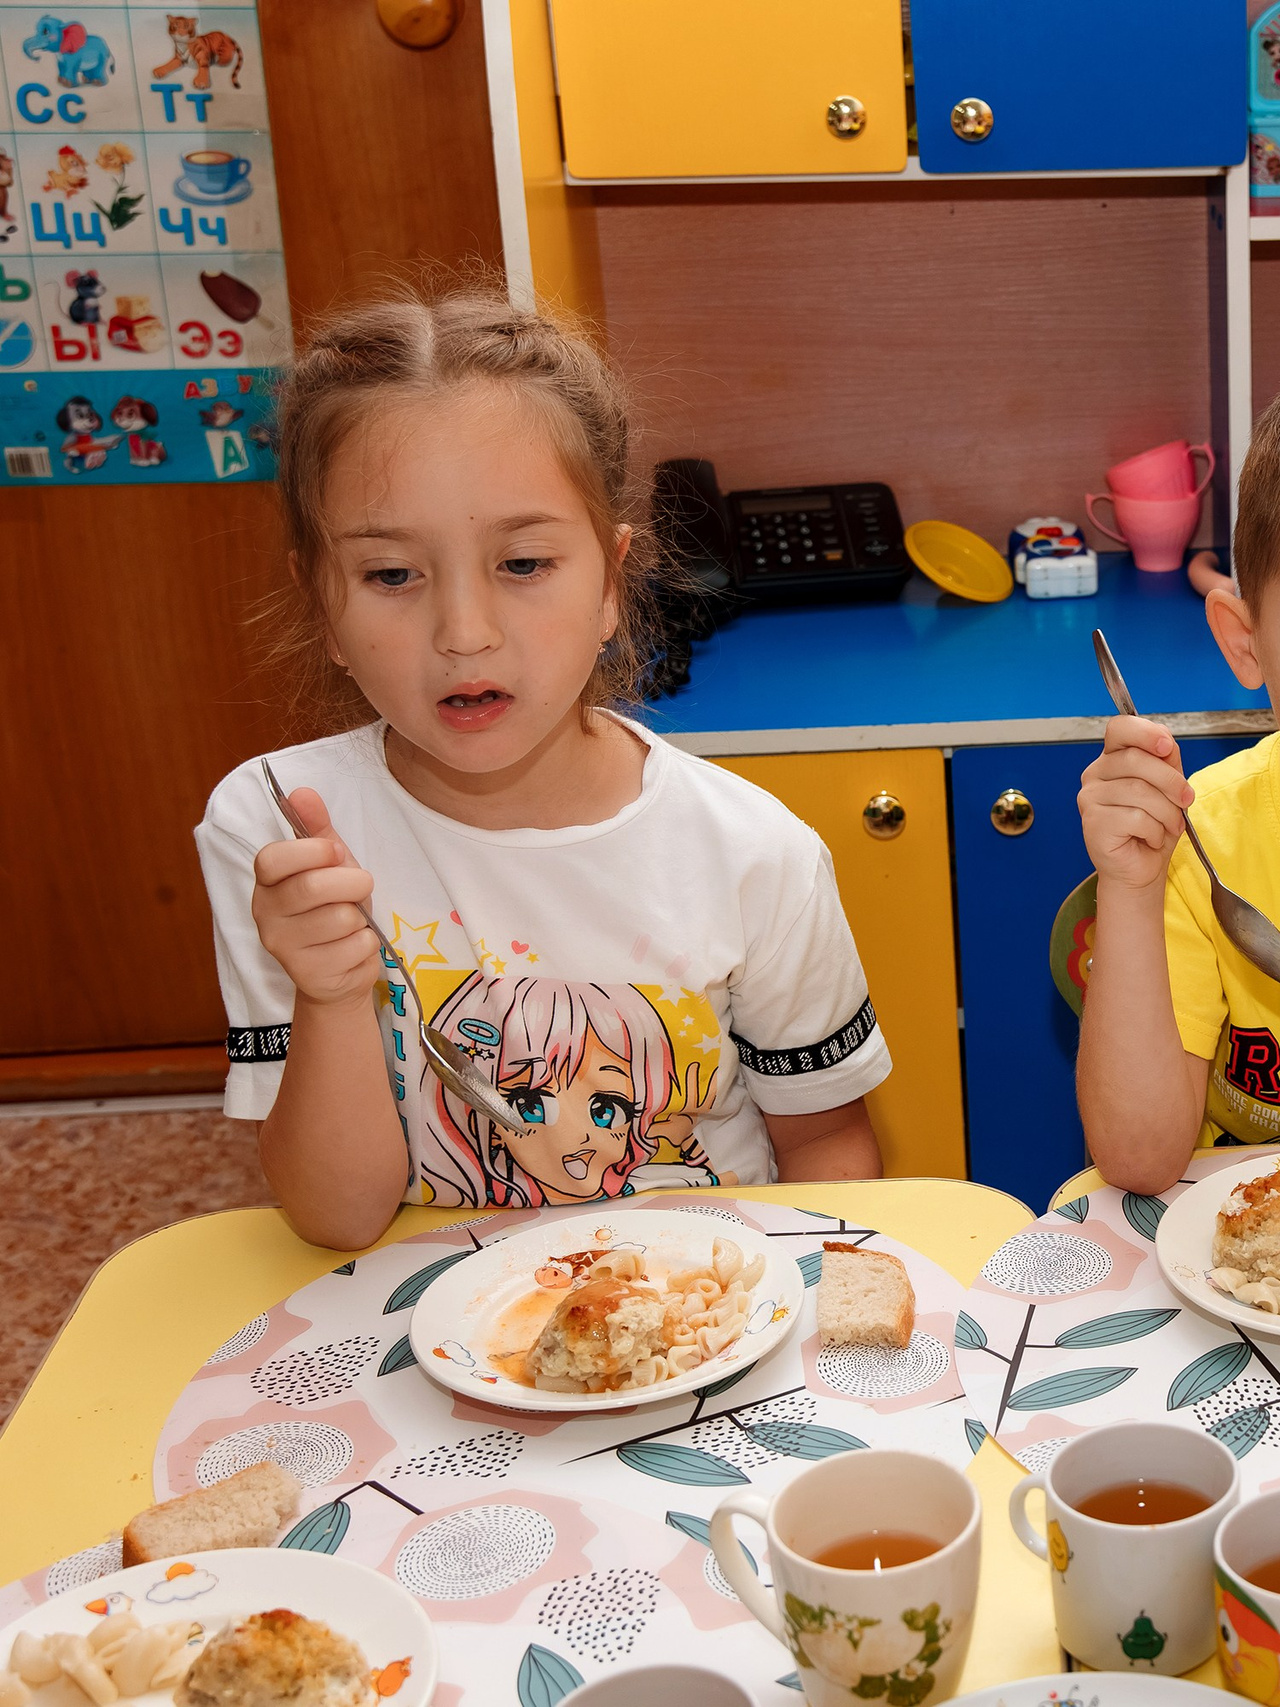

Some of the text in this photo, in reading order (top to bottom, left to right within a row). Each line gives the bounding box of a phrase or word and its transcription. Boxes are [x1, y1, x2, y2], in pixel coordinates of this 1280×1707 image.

[16, 83, 87, 124] Сс
[150, 83, 213, 123] Тт
[30, 202, 106, 249] Цц
[159, 207, 228, 247] Чч
[51, 324, 101, 362] Ы
[178, 321, 243, 359] Ээ
[820, 1017, 865, 1065] ENJOY
